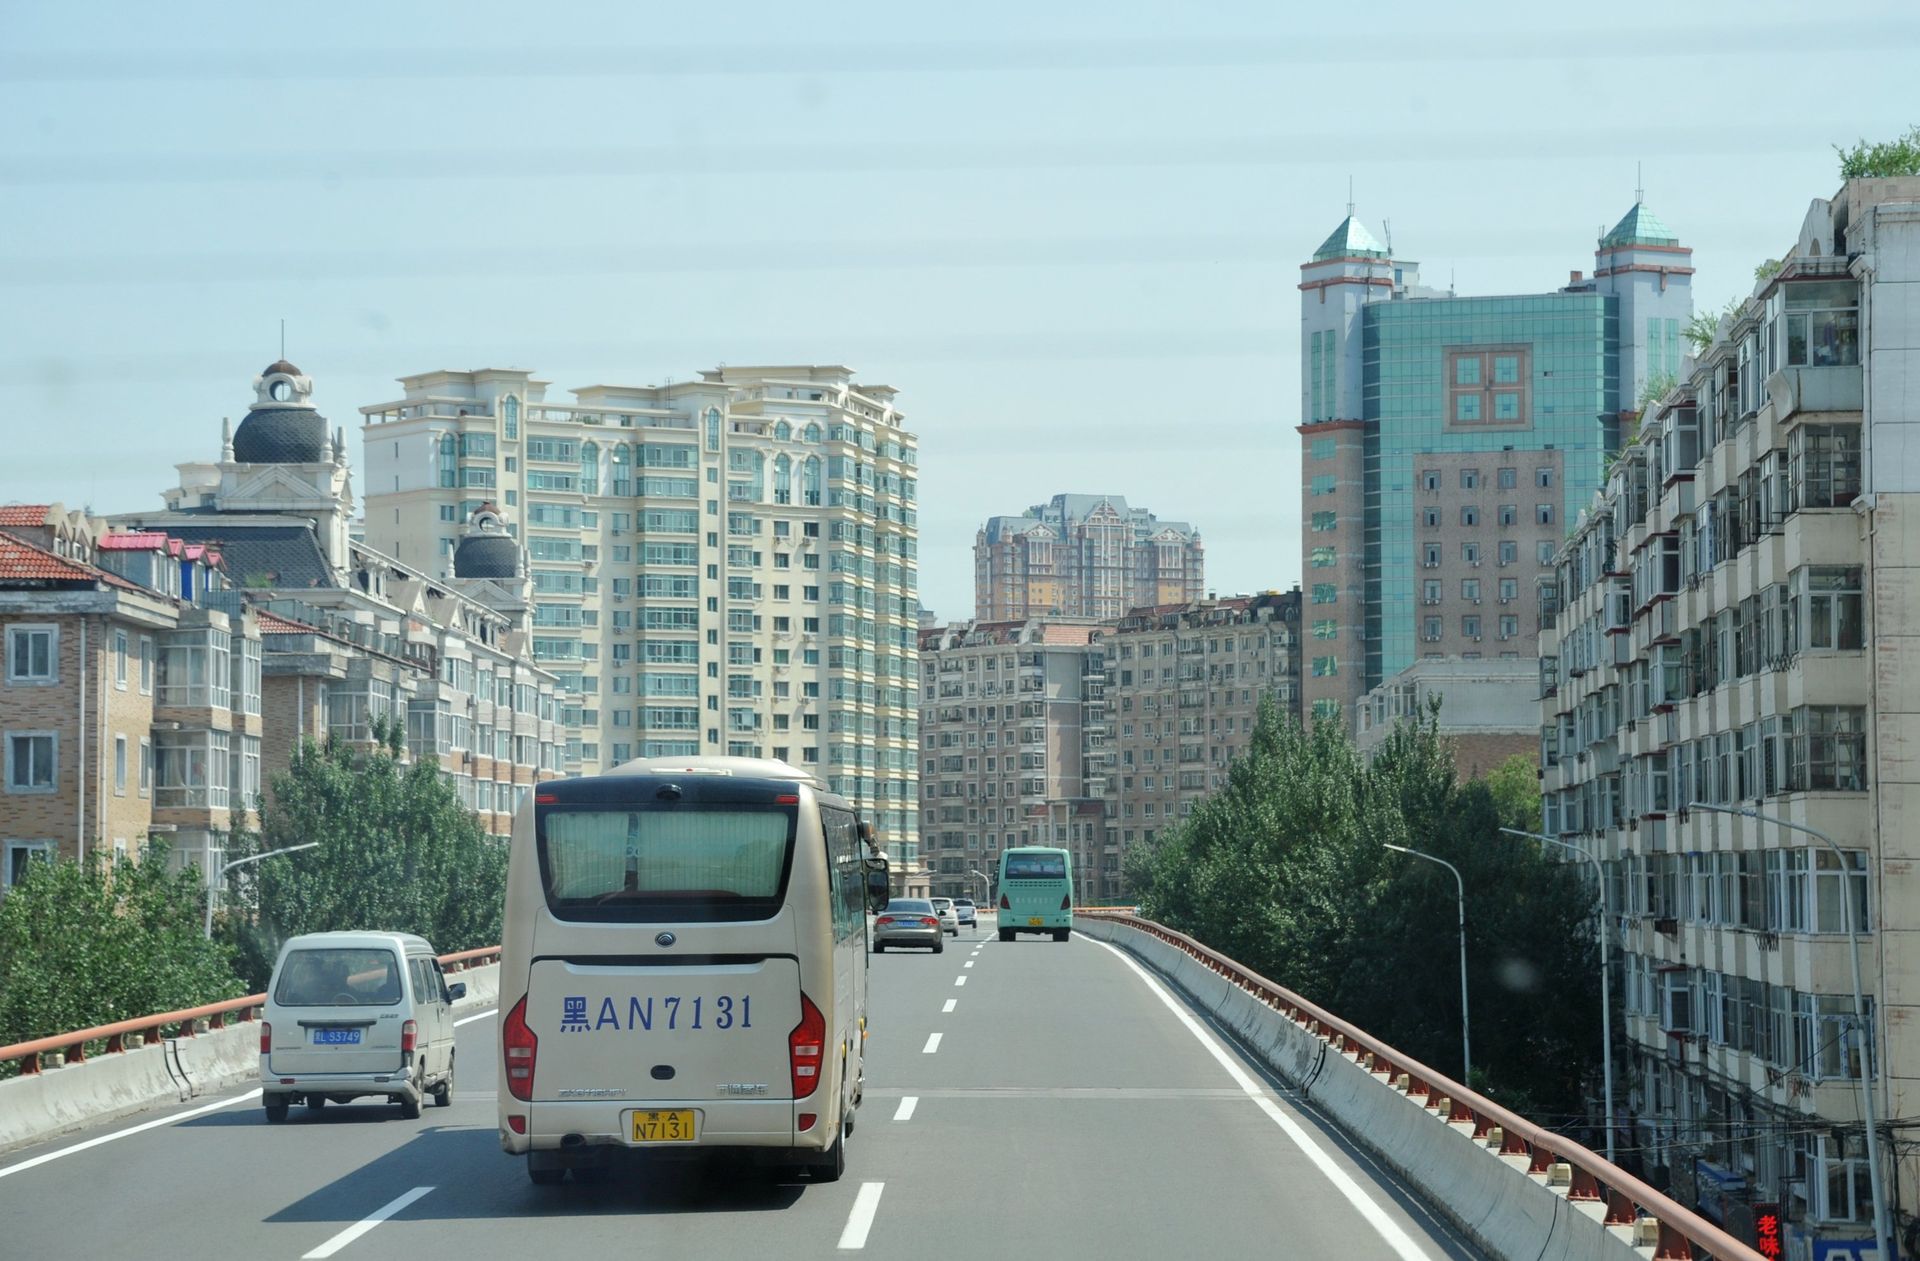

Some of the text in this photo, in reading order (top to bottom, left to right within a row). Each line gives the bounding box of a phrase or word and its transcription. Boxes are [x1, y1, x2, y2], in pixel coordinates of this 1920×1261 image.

[560, 995, 752, 1033] 黑AN7131
[635, 1122, 688, 1139] N7131
[1757, 1215, 1781, 1261] 老味
